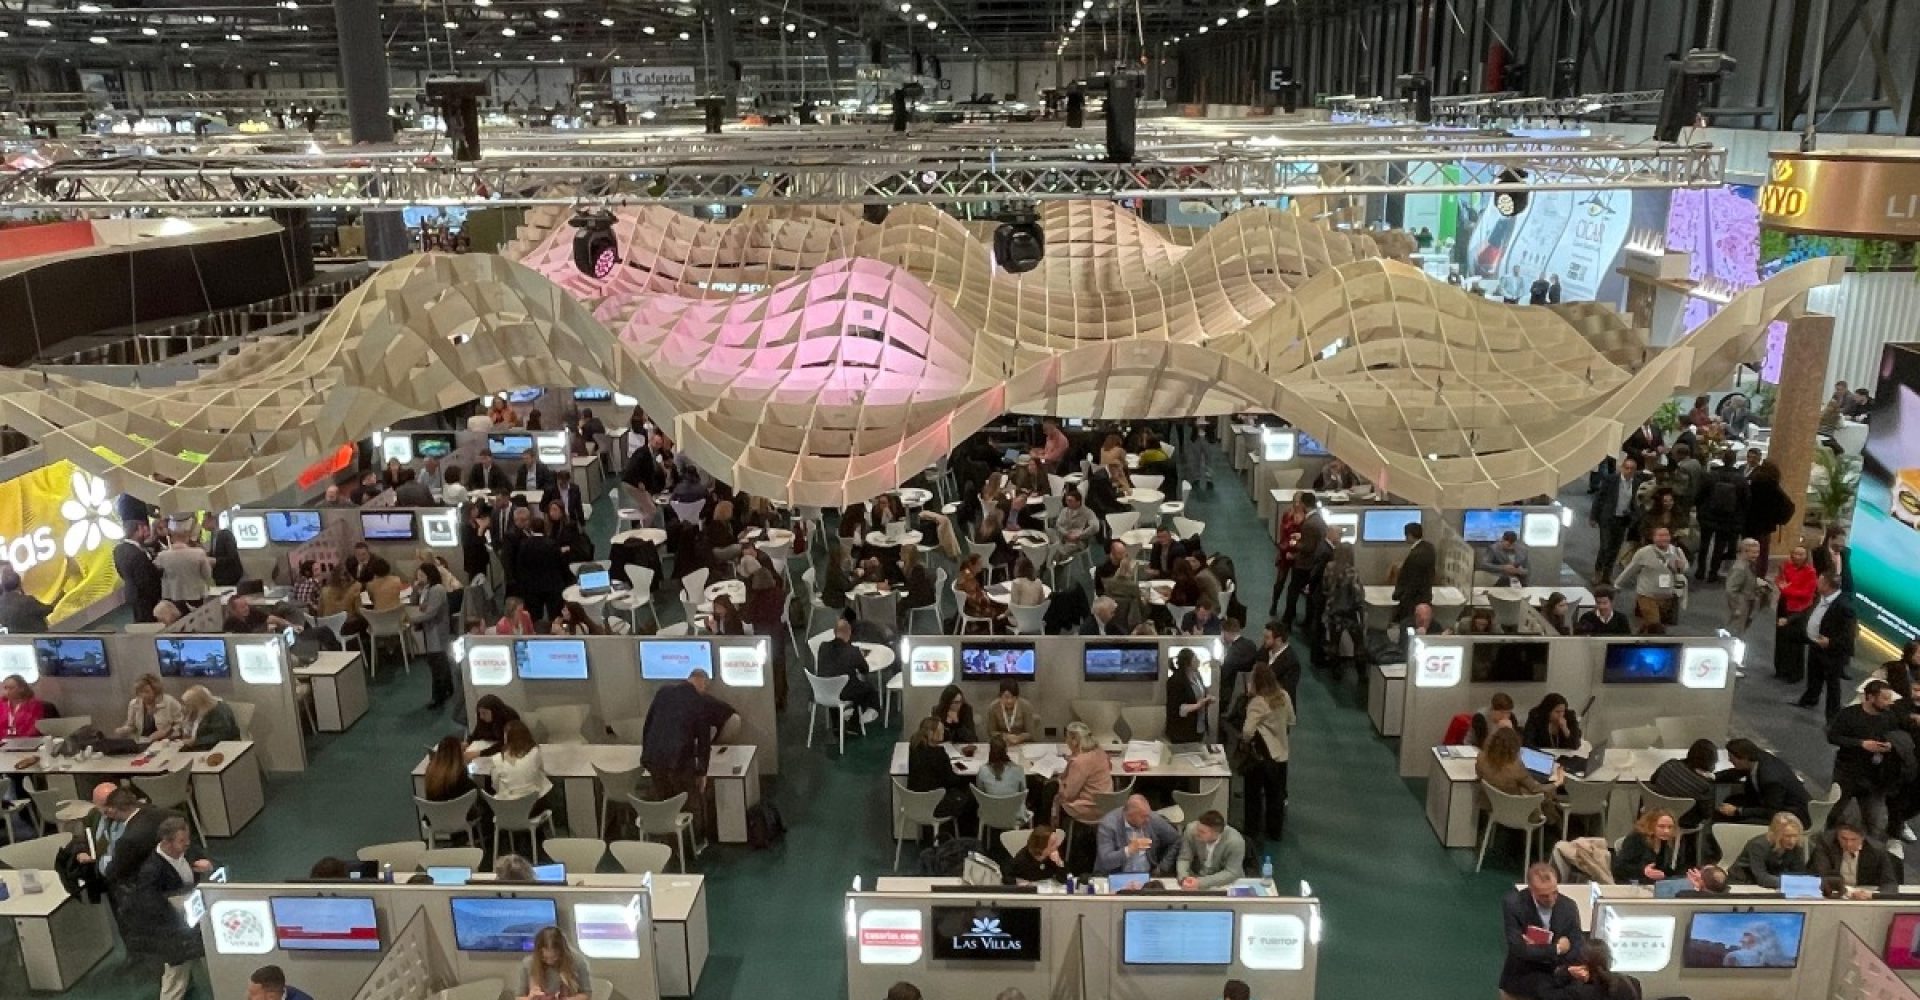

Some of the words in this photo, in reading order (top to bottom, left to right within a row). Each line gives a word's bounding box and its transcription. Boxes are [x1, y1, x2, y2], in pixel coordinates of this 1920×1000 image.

[1269, 69, 1283, 91] E
[1425, 655, 1456, 673] GF
[952, 936, 977, 950] LAS
[981, 937, 1022, 950] VILLAS
